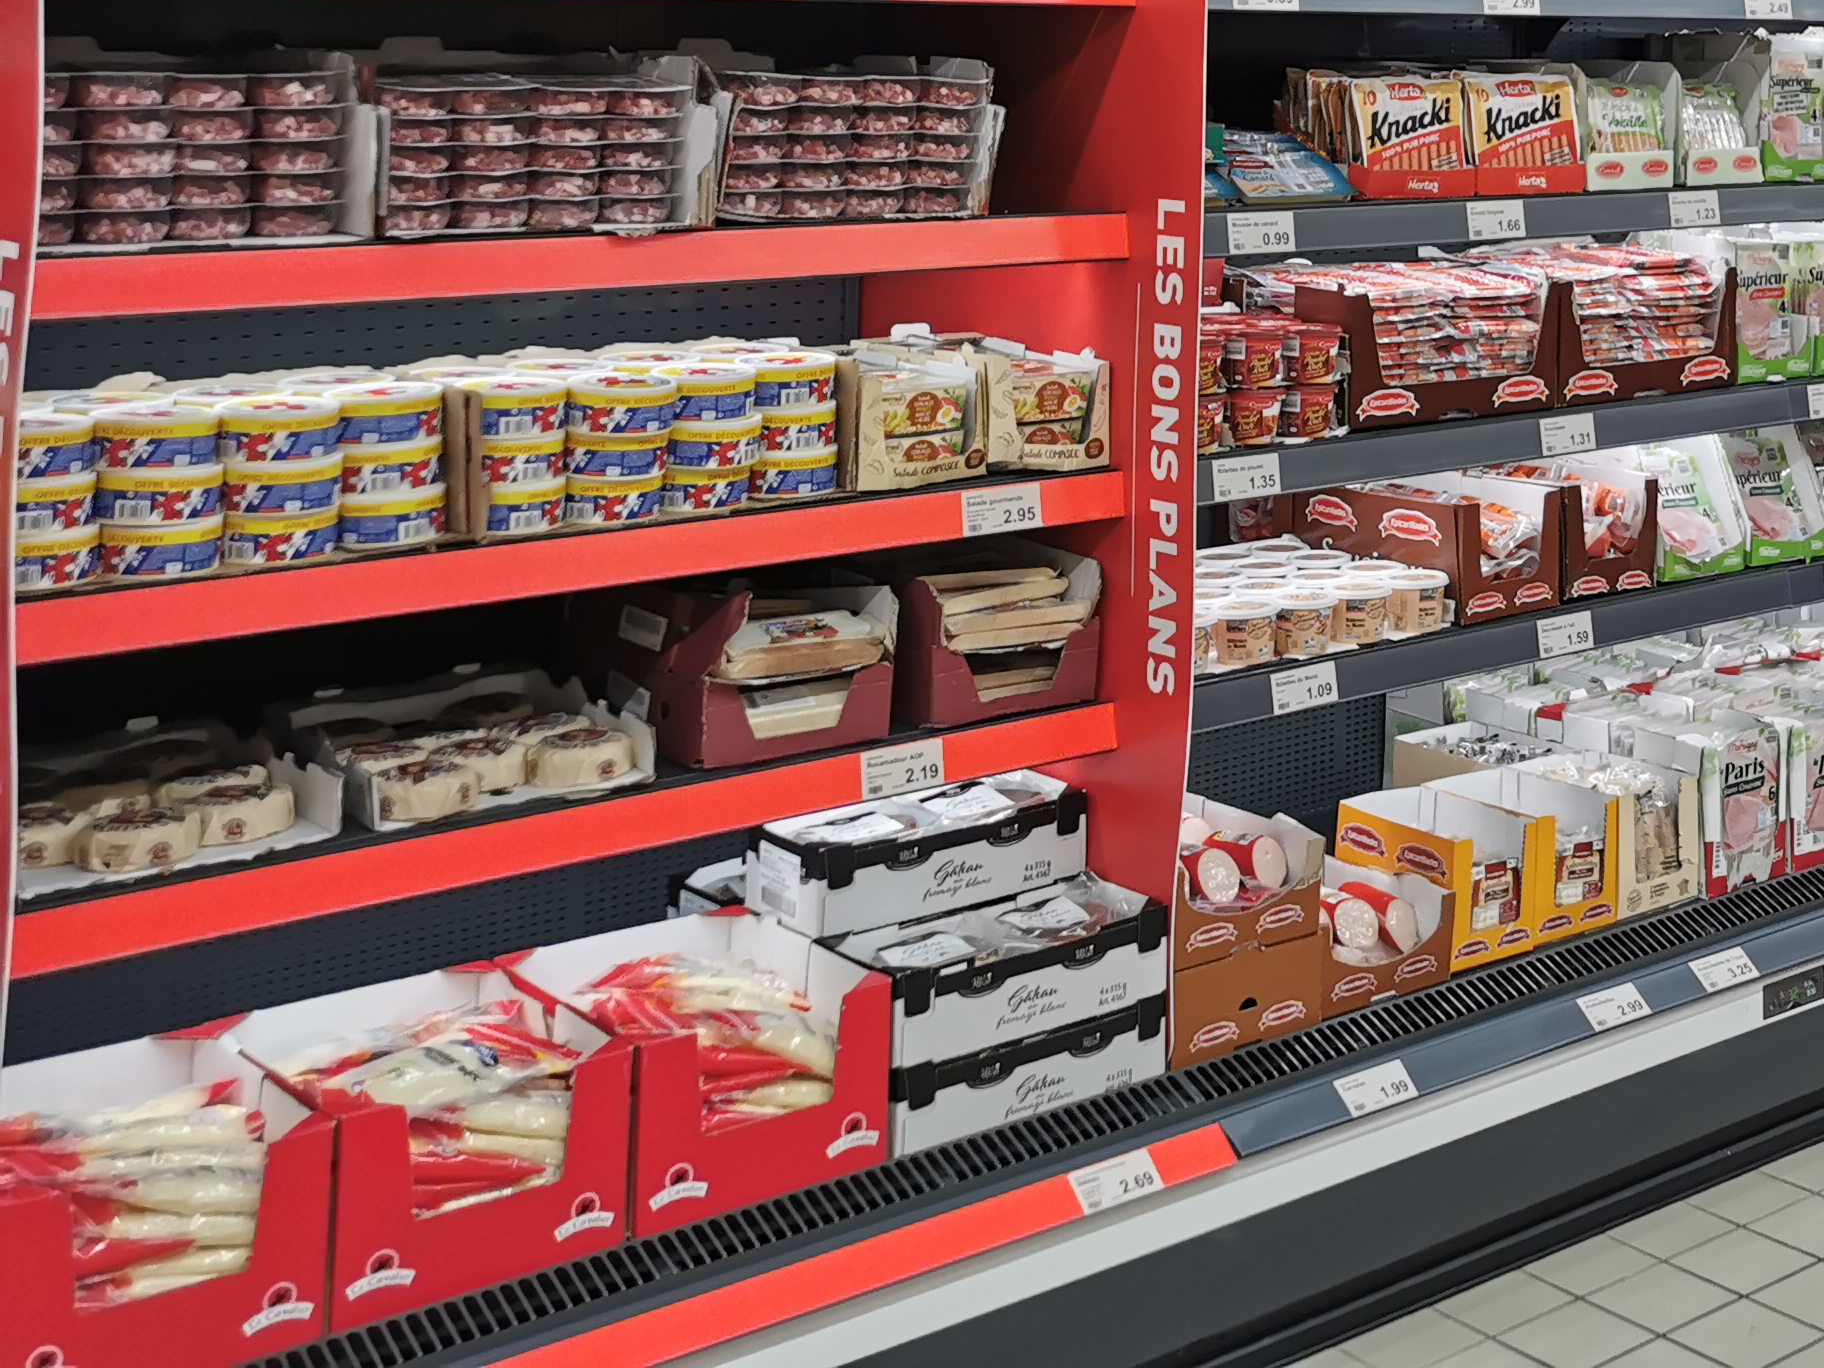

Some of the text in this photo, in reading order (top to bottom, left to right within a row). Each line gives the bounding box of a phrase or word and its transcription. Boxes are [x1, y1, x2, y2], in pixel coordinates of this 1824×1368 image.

[1769, 3, 1789, 14] 2.49
[1390, 84, 1422, 100] Herta
[1476, 89, 1489, 103] 10
[1500, 82, 1533, 97] Herta
[1362, 91, 1377, 105] 10
[1367, 97, 1451, 149] Knacki
[1485, 94, 1561, 144] Knacki
[1382, 147, 1402, 159] 100%
[1408, 178, 1438, 193] Herta
[1518, 174, 1547, 188] Herta
[1696, 209, 1716, 220] 1.23
[1498, 219, 1520, 232] 1.66
[1263, 232, 1289, 246] 0.99
[1146, 198, 1187, 696] LES BONS PLANS
[1570, 432, 1591, 447] 1.31
[1250, 474, 1276, 490] 1.35
[1003, 507, 1036, 524] 2.95
[1567, 630, 1589, 646] 1.59
[1306, 681, 1333, 700] 1.09
[905, 764, 939, 783] 2.19
[1724, 757, 1765, 781] Paris
[1726, 962, 1753, 979] 3.25
[1616, 999, 1644, 1016] 2.99
[1379, 1080, 1410, 1099] 1.99
[1119, 1172, 1155, 1196] 2.69
